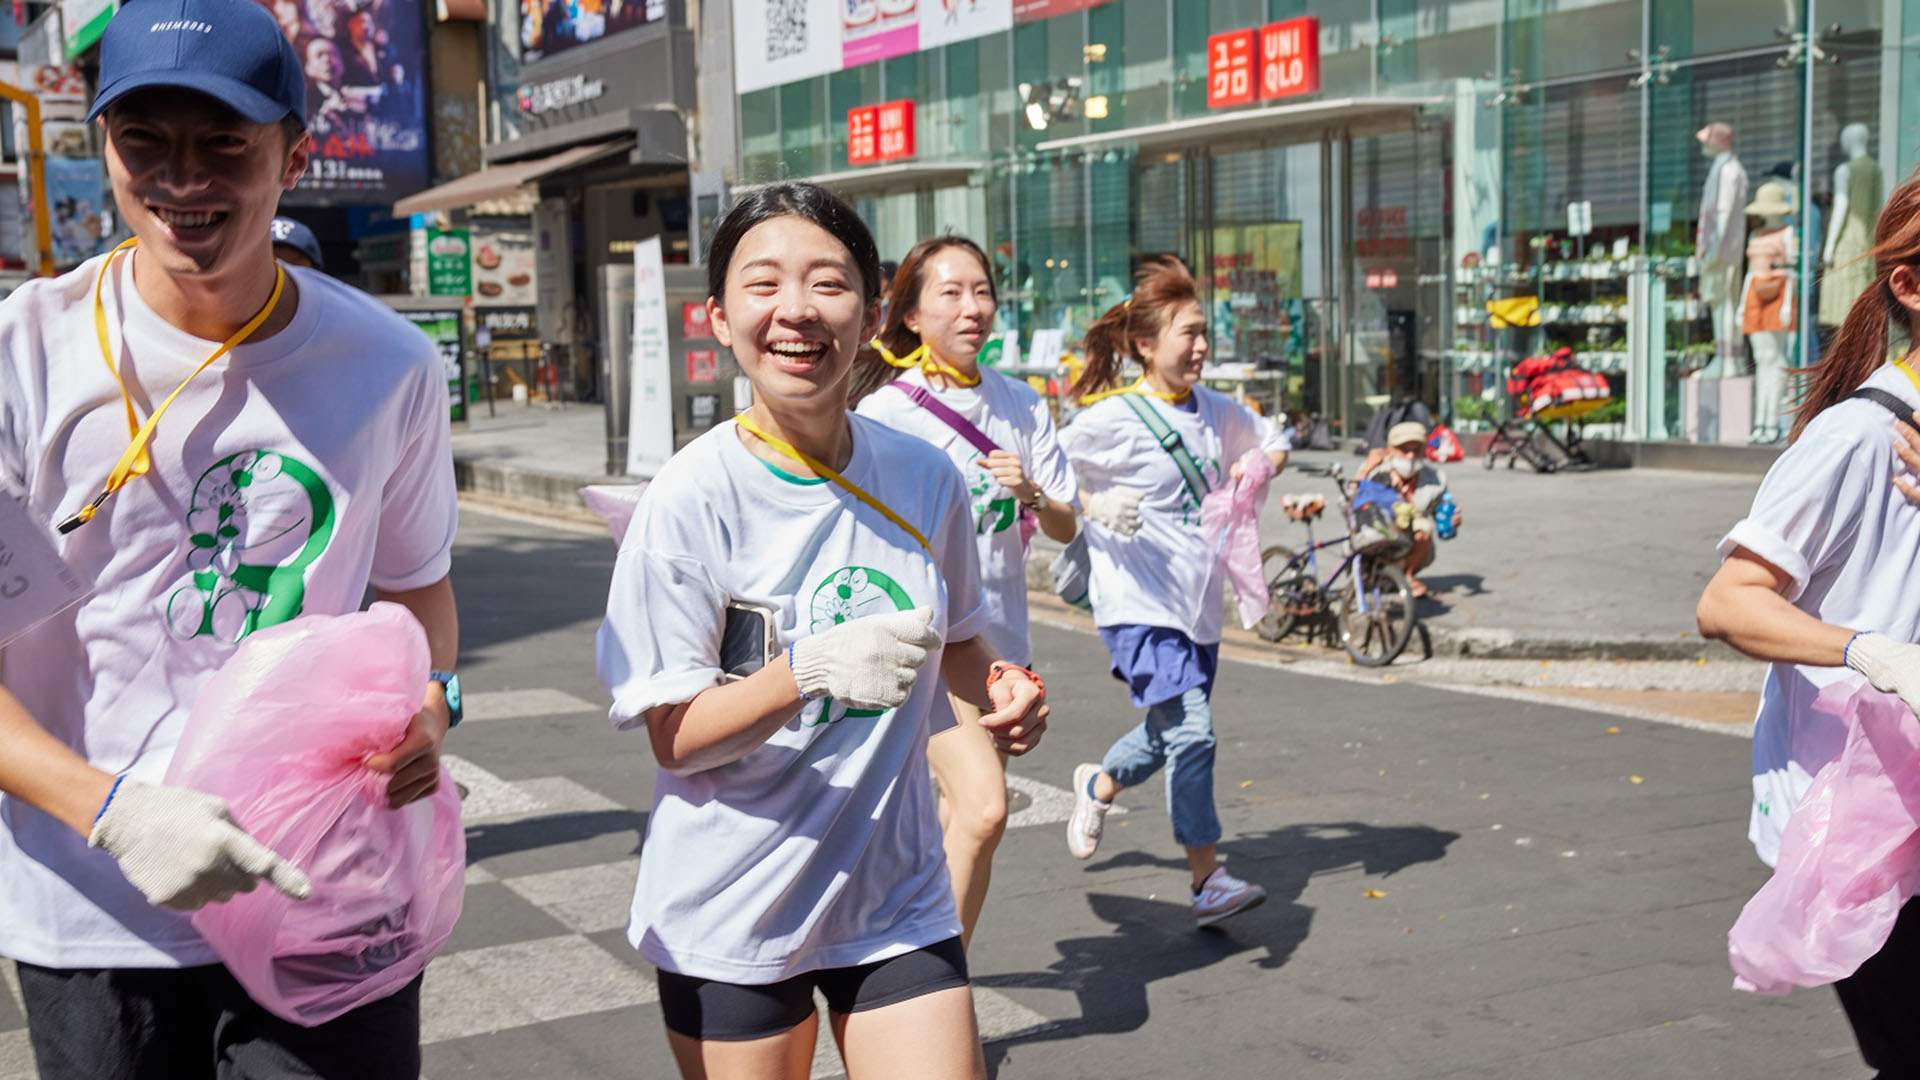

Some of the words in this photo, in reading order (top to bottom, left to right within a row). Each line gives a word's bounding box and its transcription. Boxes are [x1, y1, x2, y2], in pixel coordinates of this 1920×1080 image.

[1265, 28, 1300, 60] UNI
[1264, 57, 1303, 93] QLO
[880, 108, 902, 131] UNI
[880, 130, 904, 155] QLO
